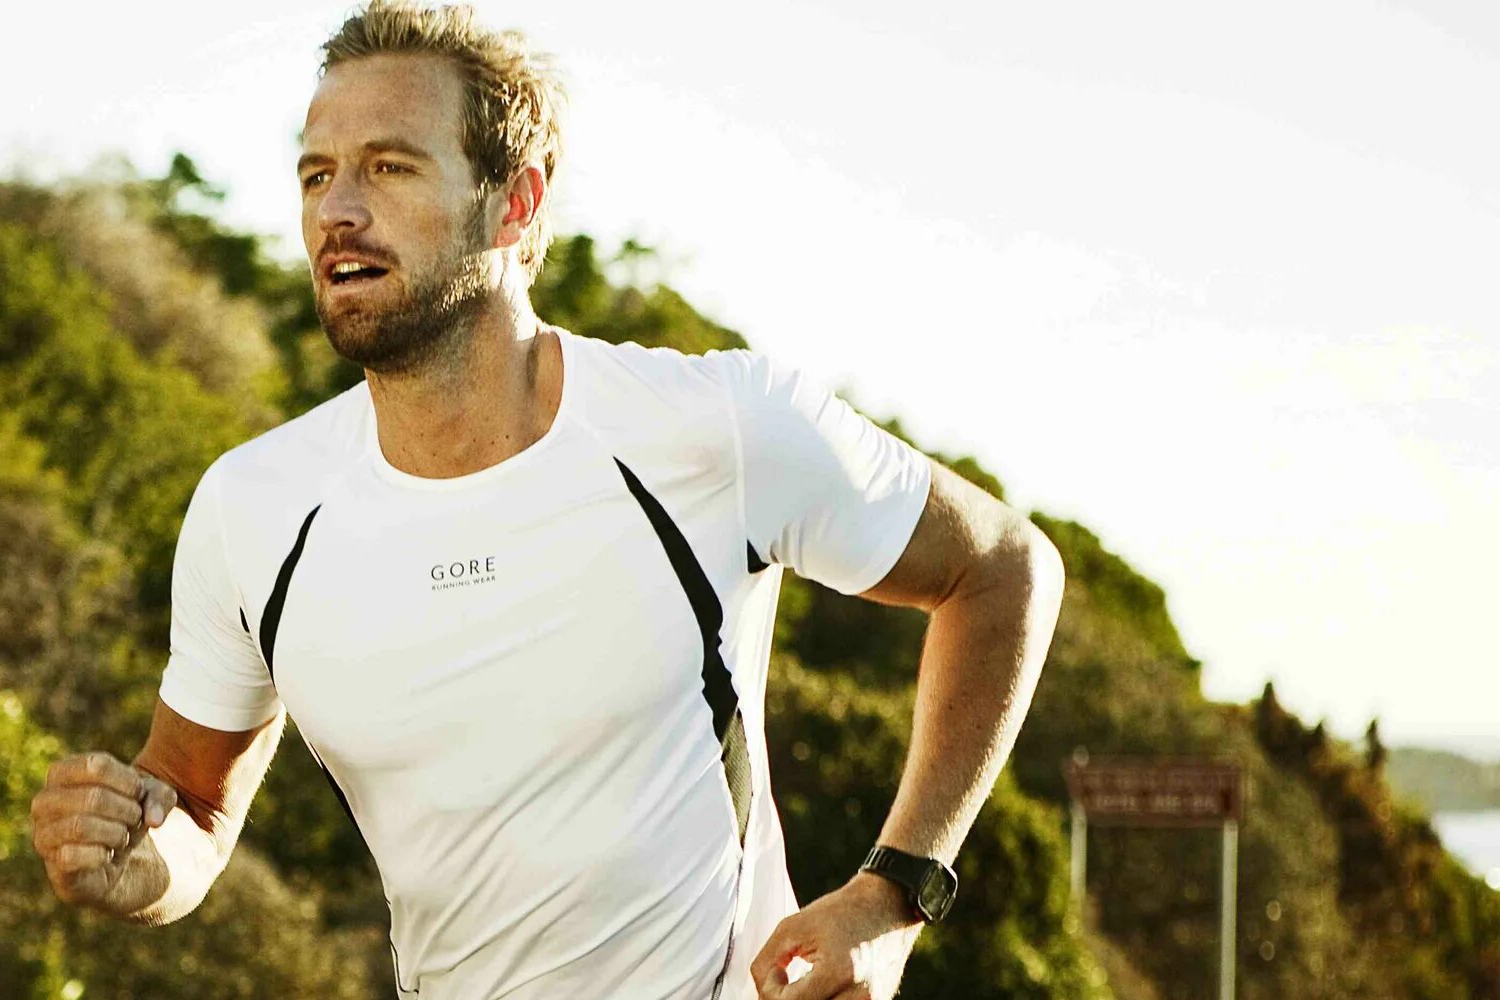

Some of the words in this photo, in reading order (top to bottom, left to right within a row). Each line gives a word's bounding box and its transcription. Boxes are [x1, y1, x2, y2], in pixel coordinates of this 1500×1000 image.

[431, 556, 495, 581] GORE
[431, 580, 470, 591] RUNNING
[473, 575, 496, 585] WEAR
